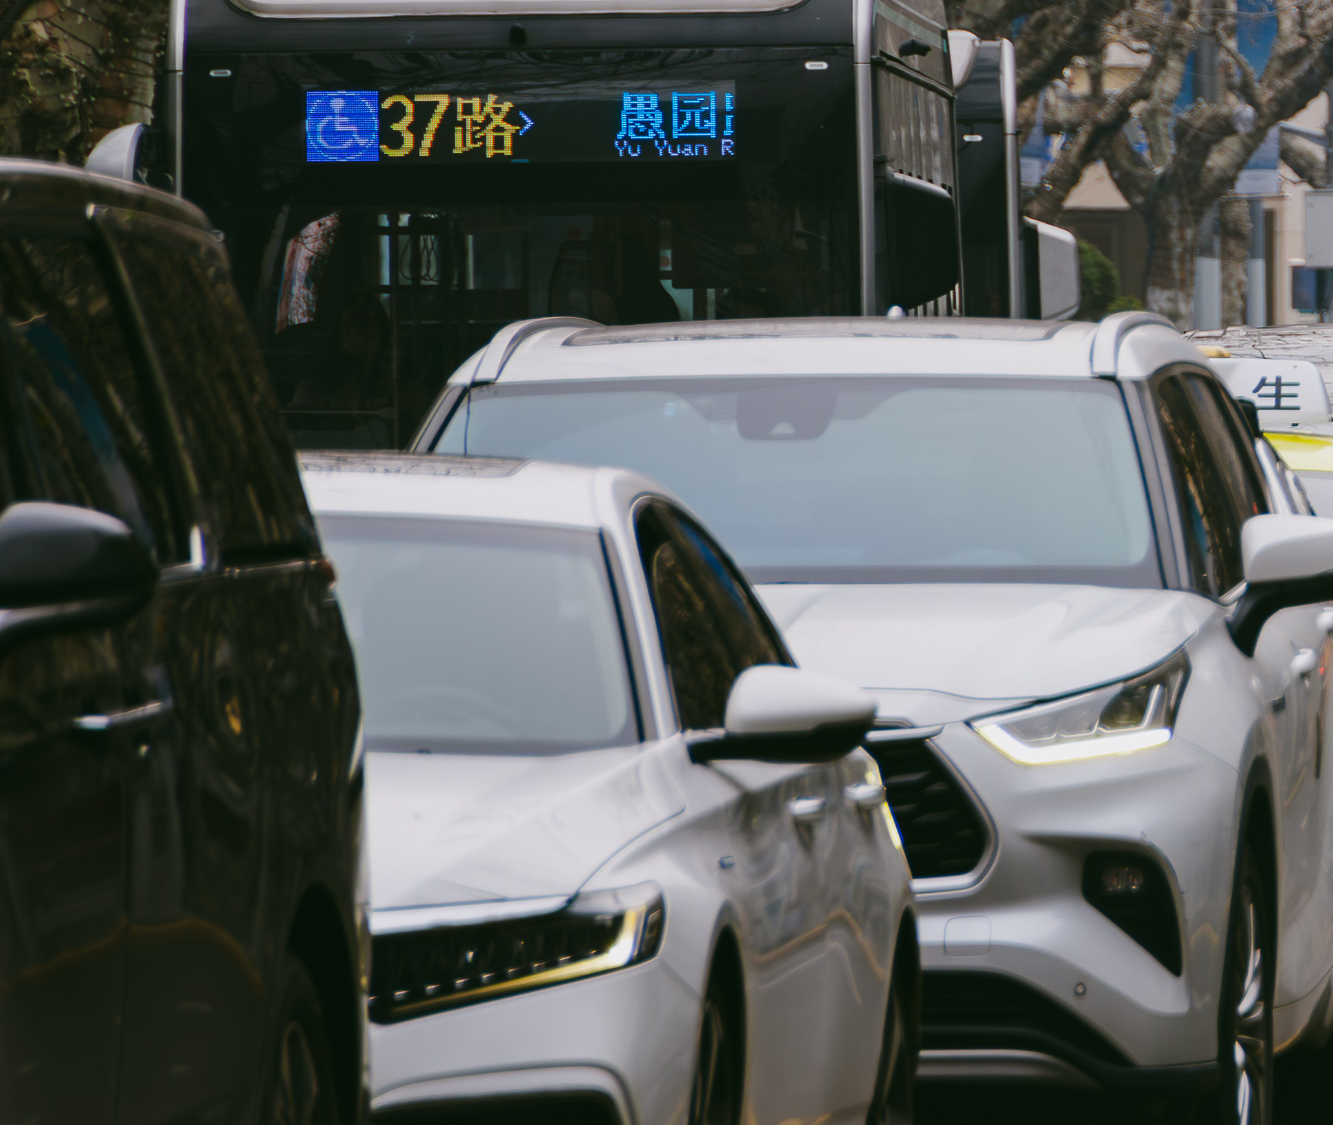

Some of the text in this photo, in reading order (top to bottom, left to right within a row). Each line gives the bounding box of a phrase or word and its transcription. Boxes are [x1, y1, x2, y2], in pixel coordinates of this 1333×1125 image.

[379, 93, 521, 158] 37路
[615, 91, 735, 139] 愚园
[614, 140, 641, 157] Yu
[655, 139, 708, 157] Yuan
